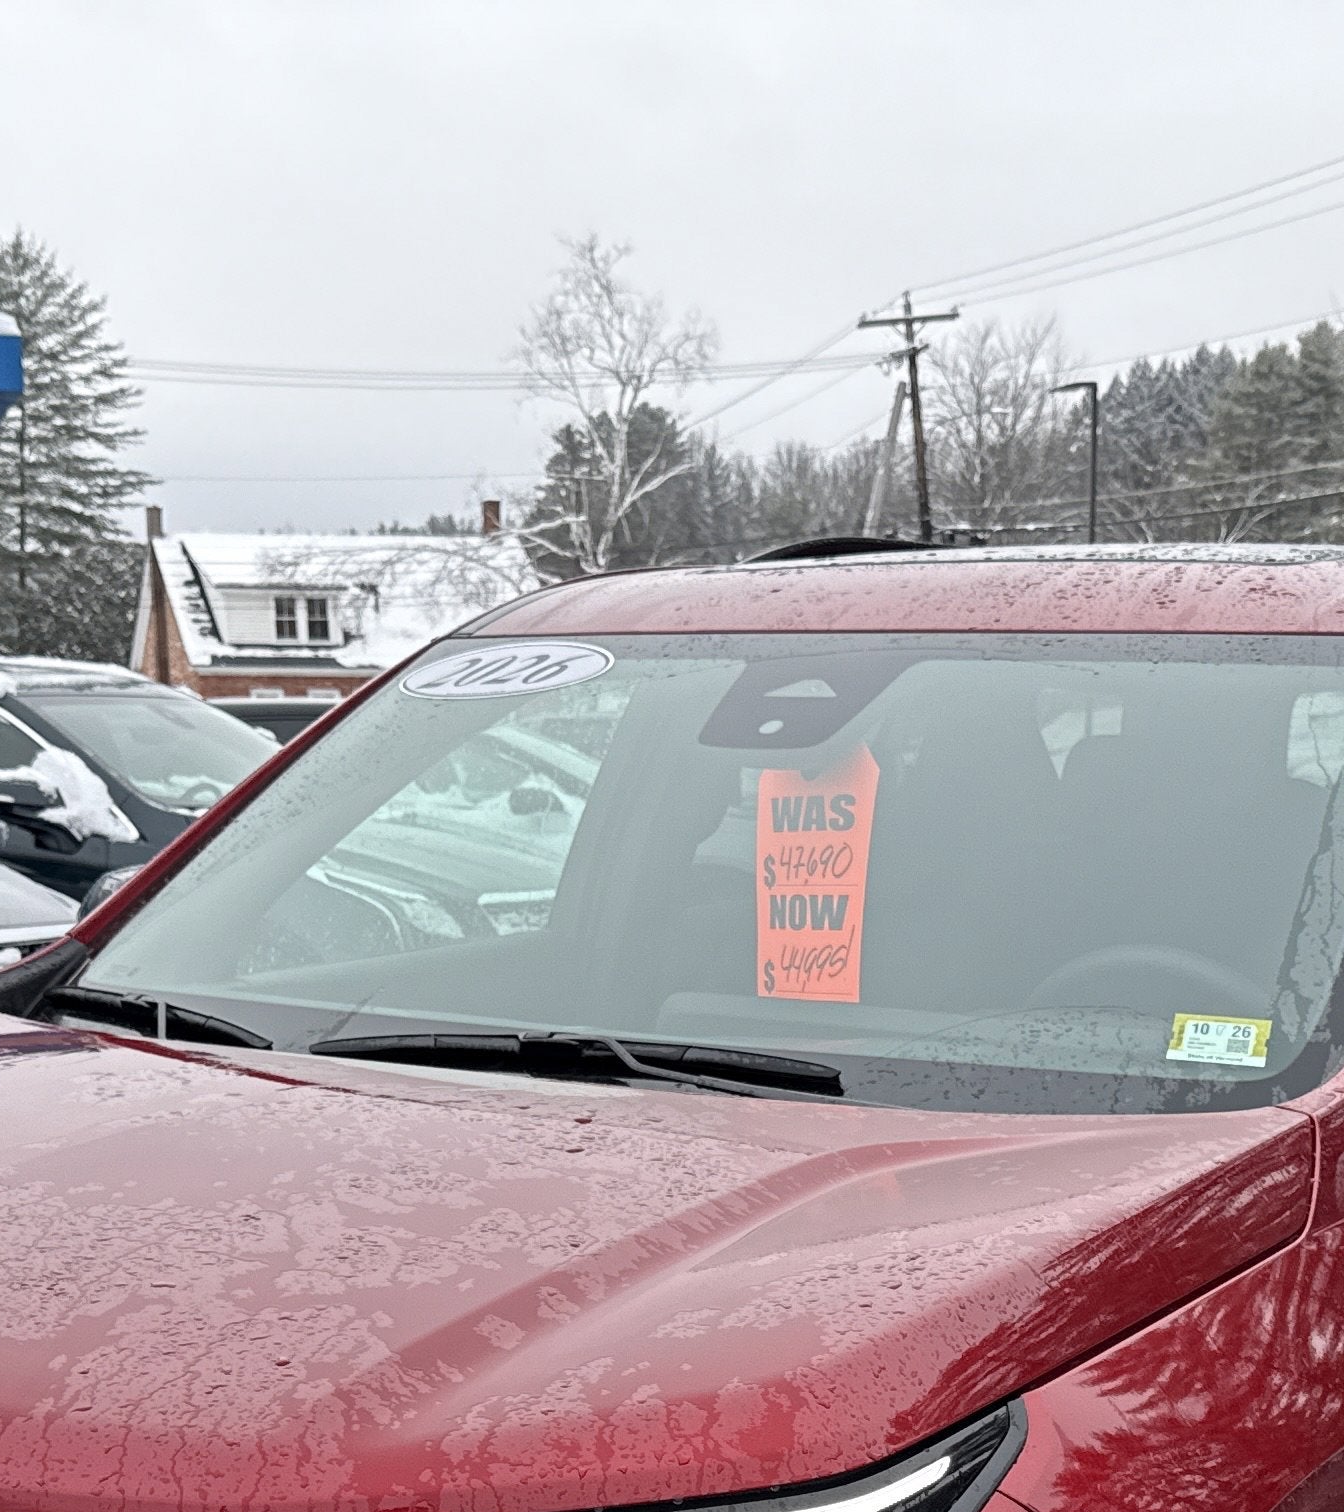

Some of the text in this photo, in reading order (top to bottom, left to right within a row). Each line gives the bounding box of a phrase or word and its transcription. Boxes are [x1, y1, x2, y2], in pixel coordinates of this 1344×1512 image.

[414, 653, 595, 690] 2026
[770, 793, 858, 833] WAS
[768, 894, 849, 931] NOW
[1192, 1023, 1252, 1039] 10 26
